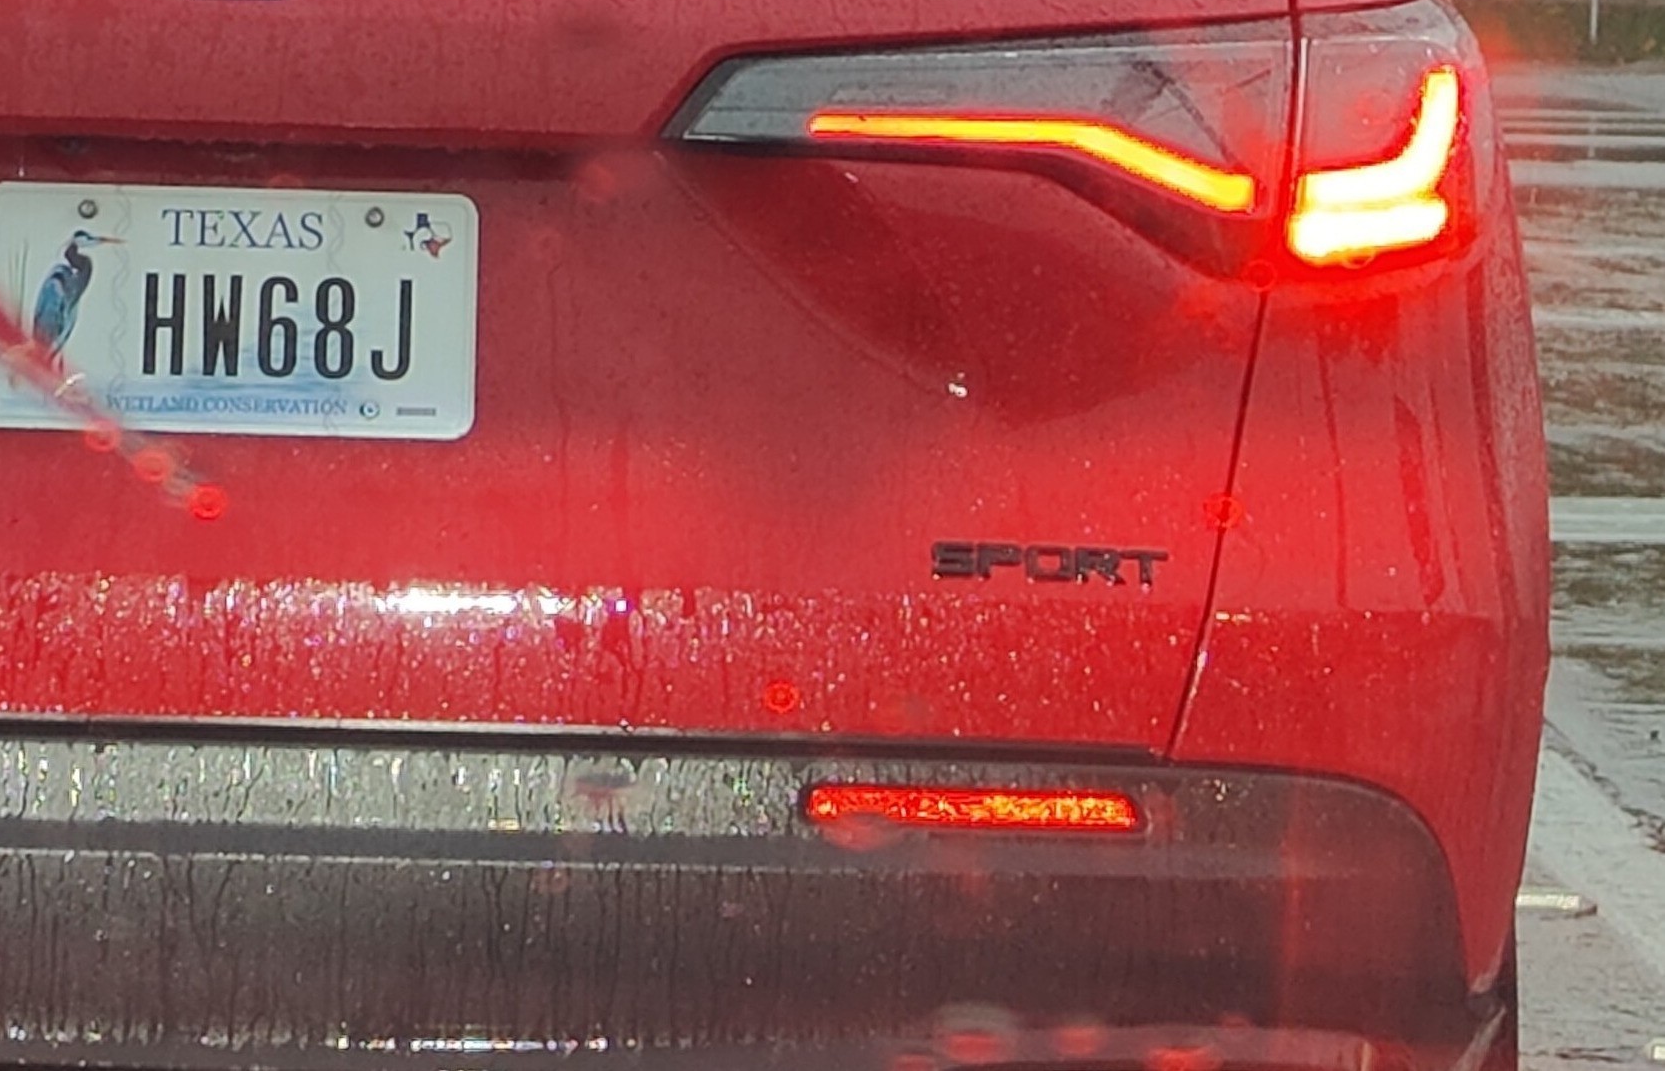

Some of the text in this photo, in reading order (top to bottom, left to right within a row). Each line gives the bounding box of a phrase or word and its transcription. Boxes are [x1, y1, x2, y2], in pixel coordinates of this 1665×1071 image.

[162, 208, 324, 251] TEXAS
[142, 272, 414, 380] HW68J
[107, 393, 348, 417] WETLAND CONSERVATION
[931, 542, 1169, 586] SPORT
